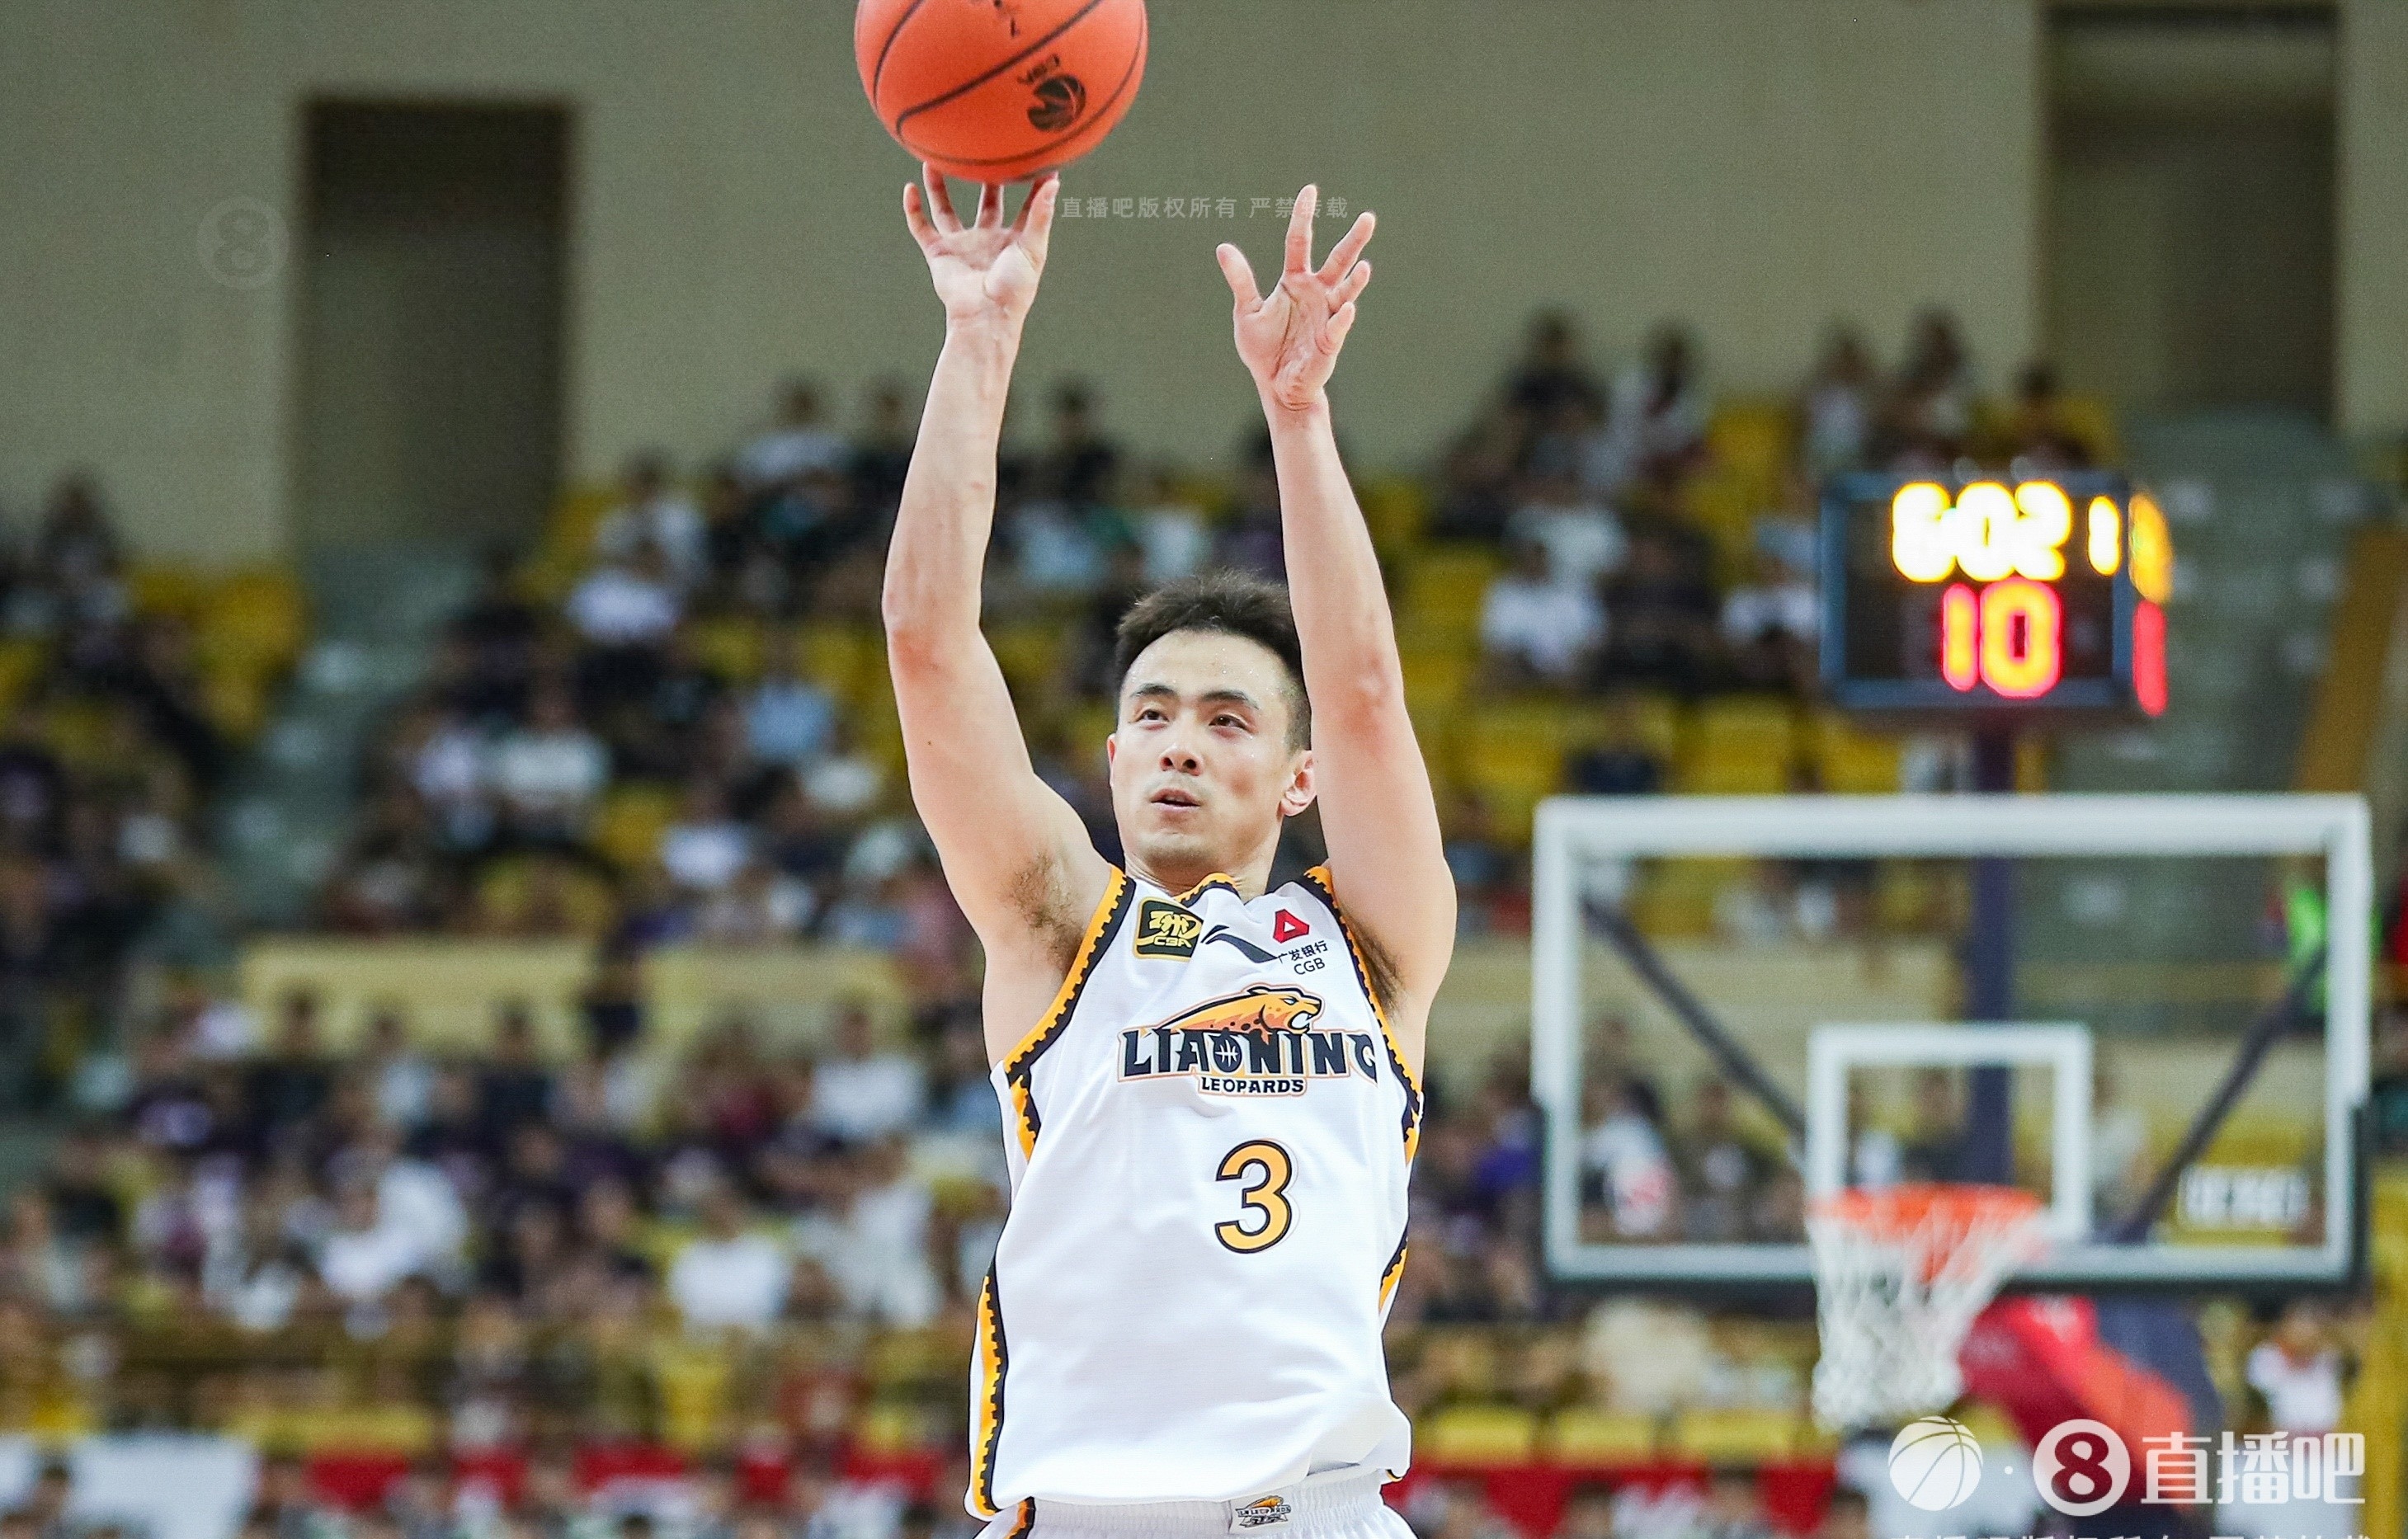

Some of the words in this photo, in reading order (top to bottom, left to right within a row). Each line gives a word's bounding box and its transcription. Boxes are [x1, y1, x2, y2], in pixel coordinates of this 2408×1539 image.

[1943, 581, 2062, 698] 10
[1154, 937, 1193, 948] CBA
[1294, 958, 1326, 975] CGB
[1201, 1077, 1303, 1094] LEOPARDS
[1214, 1140, 1292, 1254] 3
